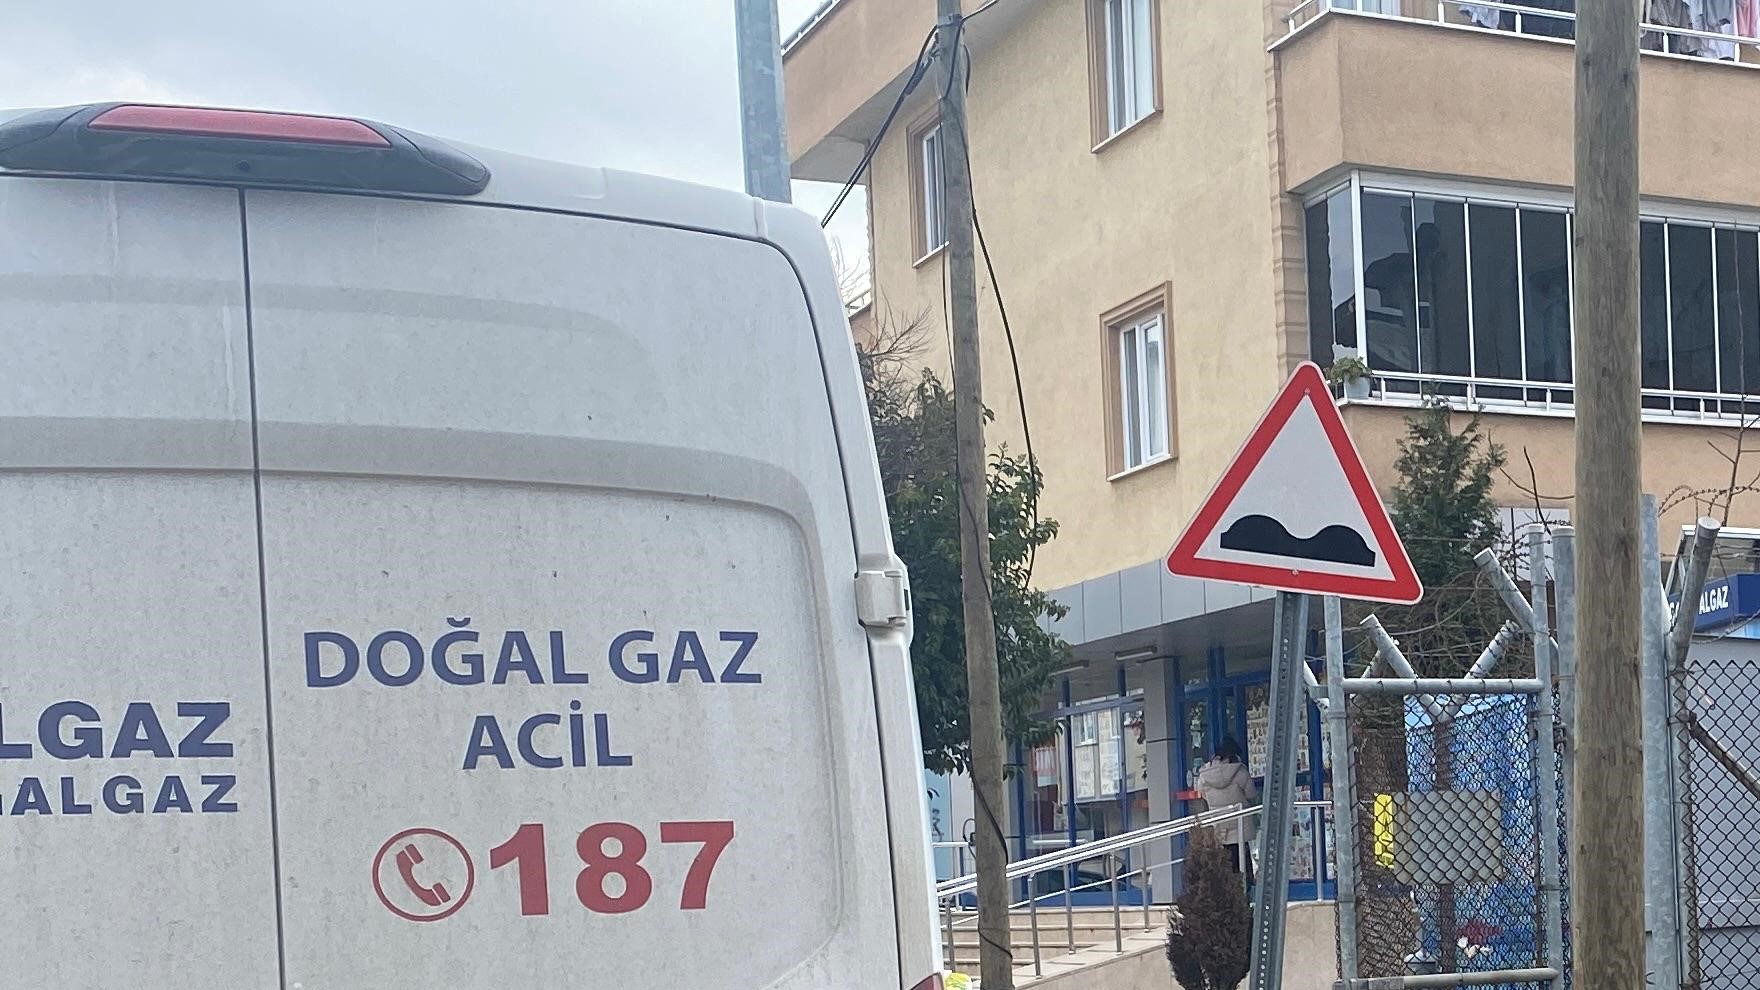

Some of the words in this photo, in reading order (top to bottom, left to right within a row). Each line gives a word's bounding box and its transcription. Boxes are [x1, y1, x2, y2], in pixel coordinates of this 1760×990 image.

[1699, 585, 1729, 614] ALGAZ
[303, 617, 588, 688] DOĞAL
[610, 630, 763, 685] GAZ
[463, 699, 633, 770] ACİL
[0, 775, 238, 816] ALGAZ
[489, 821, 736, 917] 187
